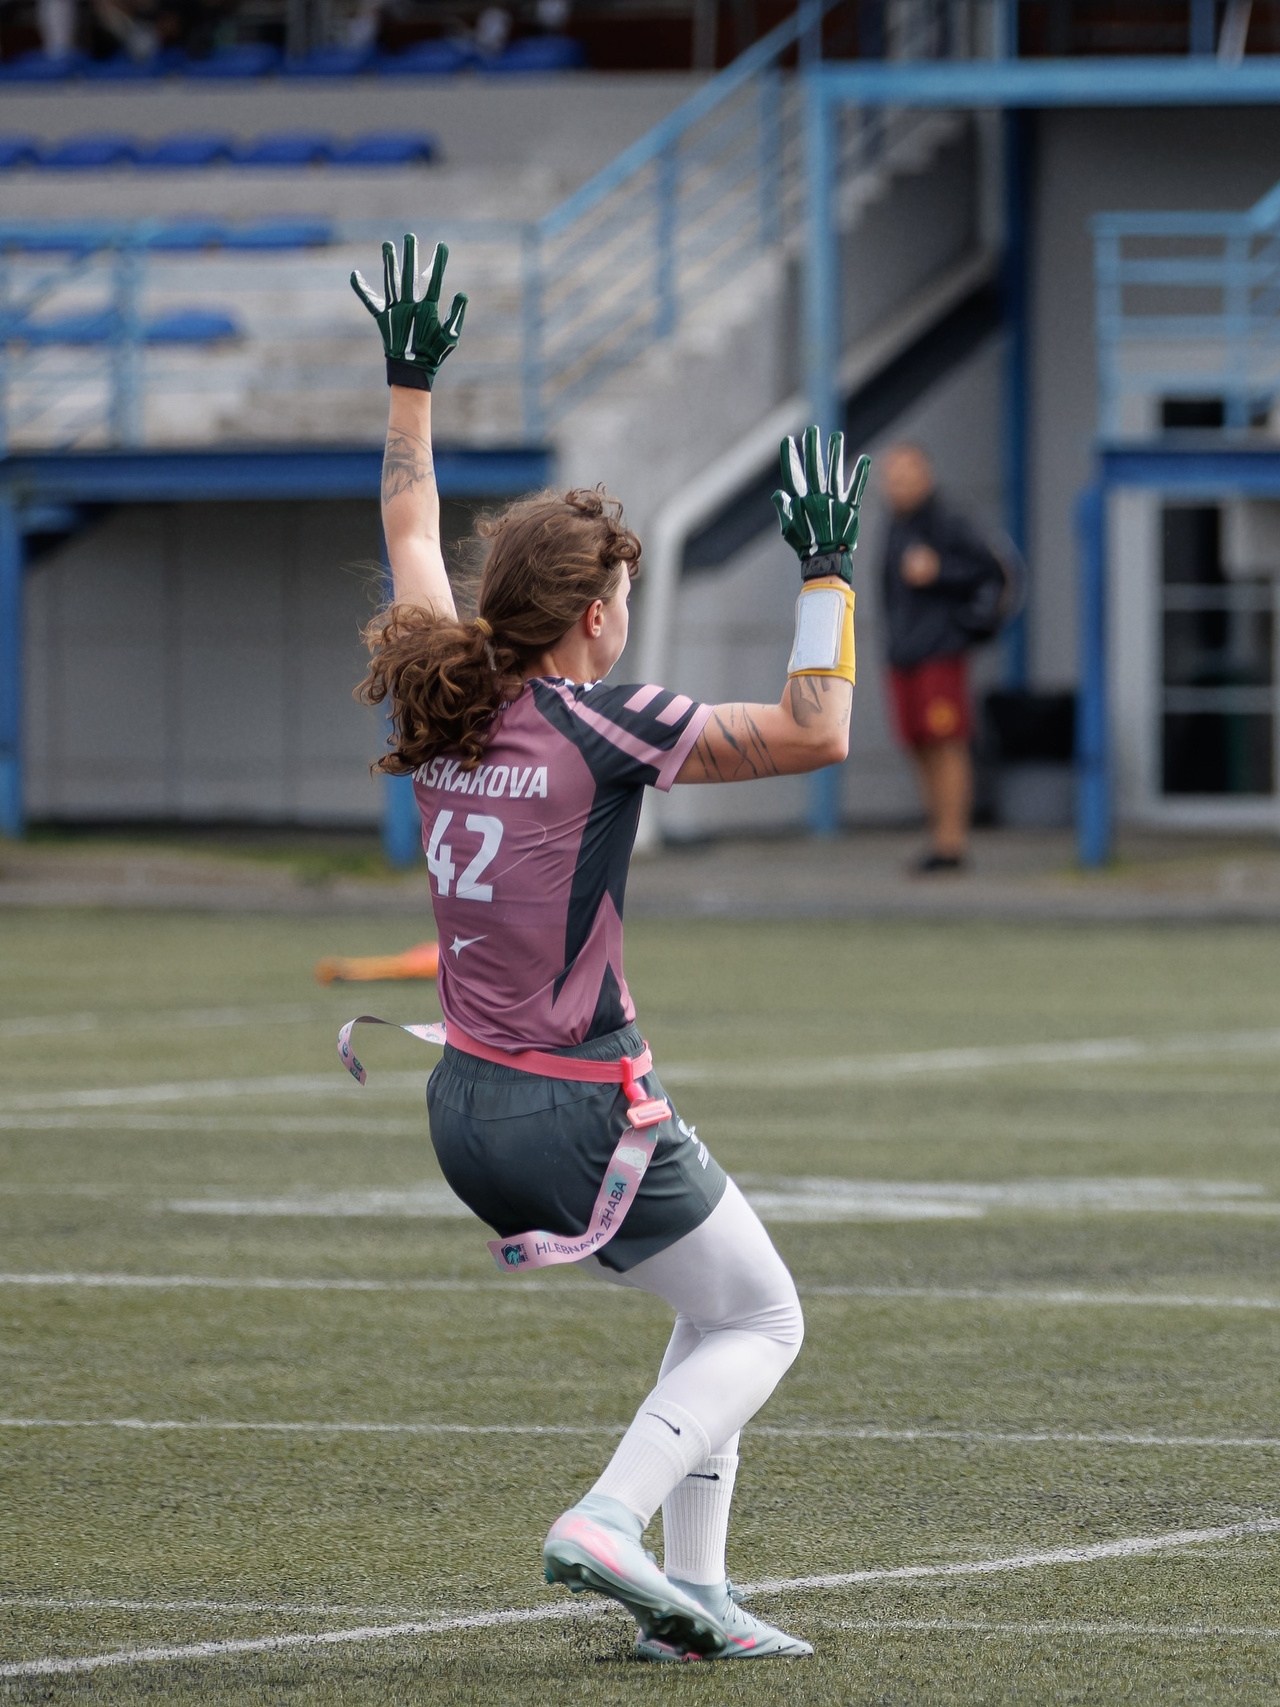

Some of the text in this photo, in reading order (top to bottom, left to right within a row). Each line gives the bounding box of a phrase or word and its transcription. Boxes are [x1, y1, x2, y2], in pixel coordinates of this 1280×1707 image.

[412, 756, 548, 798] ASKAKOVA
[426, 809, 504, 902] 42
[535, 1232, 605, 1255] HLEBNAYA
[600, 1181, 627, 1230] ZHABA
